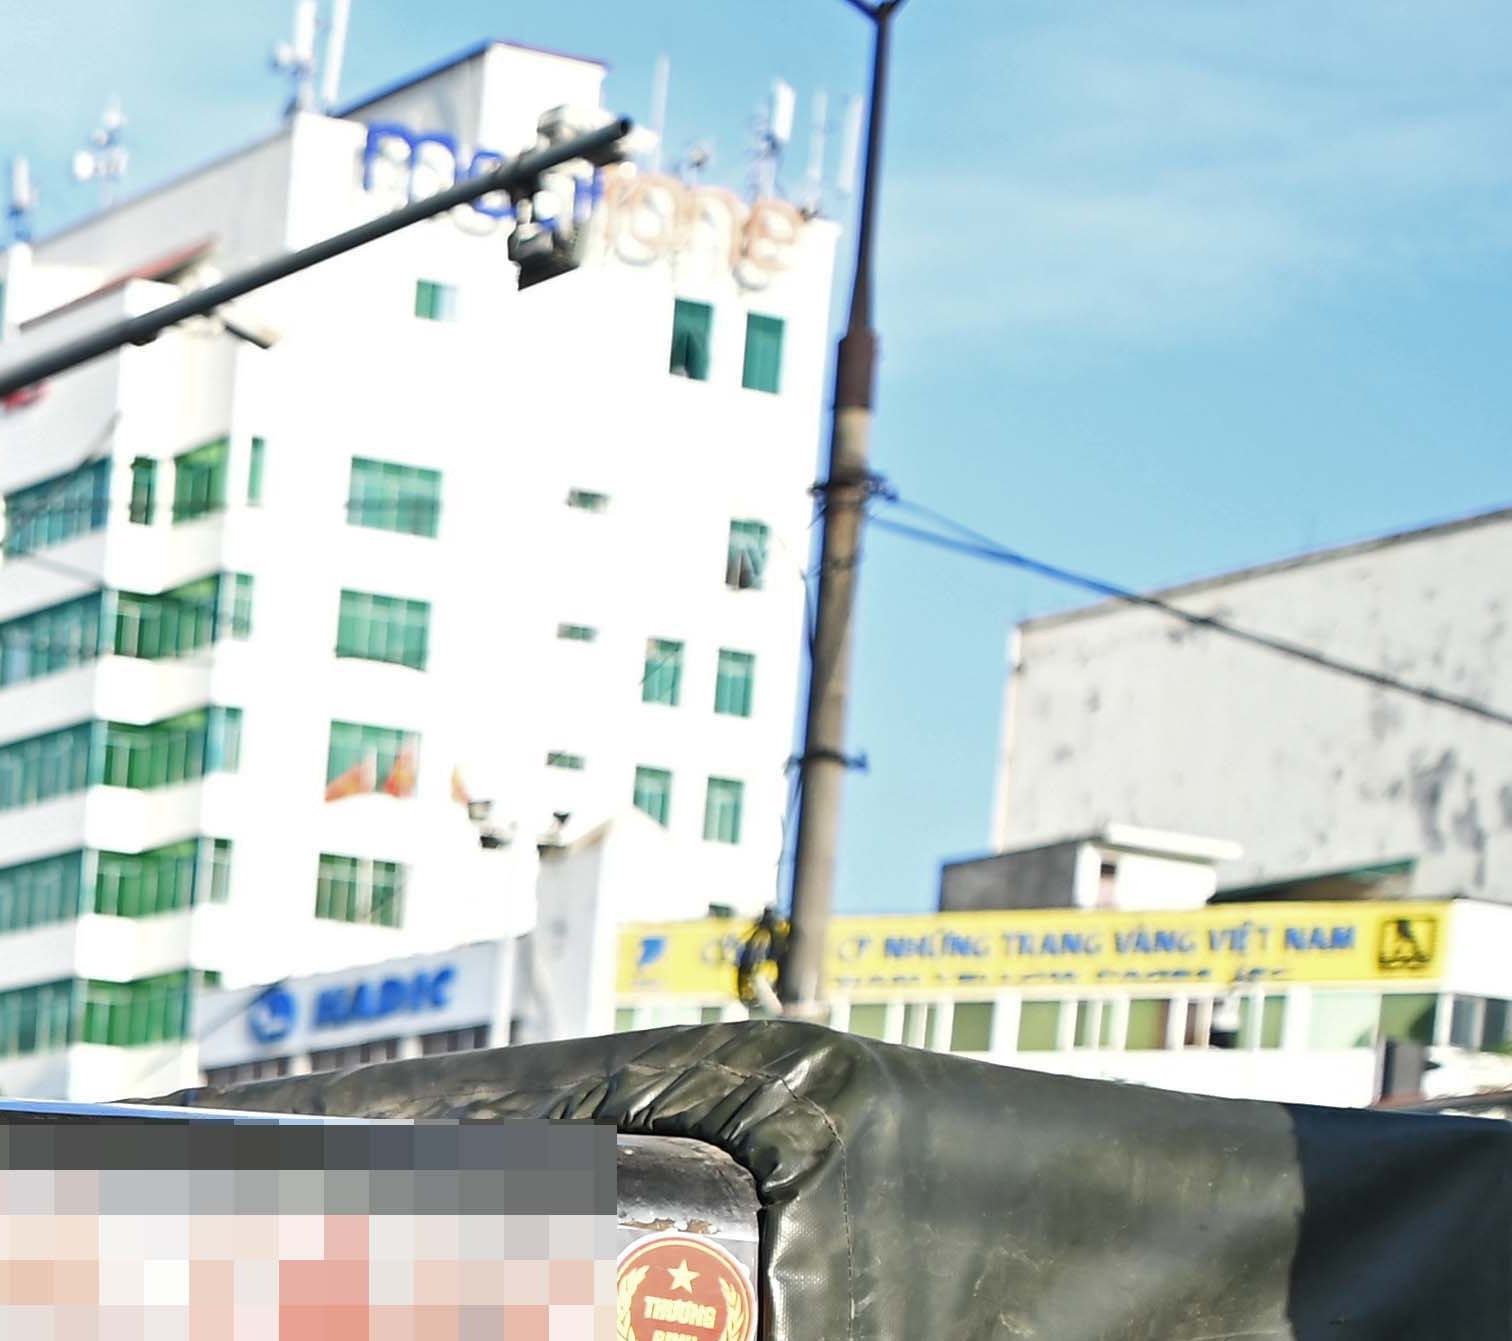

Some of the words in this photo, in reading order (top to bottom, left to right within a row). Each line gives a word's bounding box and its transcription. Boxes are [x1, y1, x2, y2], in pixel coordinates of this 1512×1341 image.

[1002, 931, 1101, 956] TRANG
[1114, 920, 1195, 953] VÀNG
[1284, 923, 1357, 951] NAM
